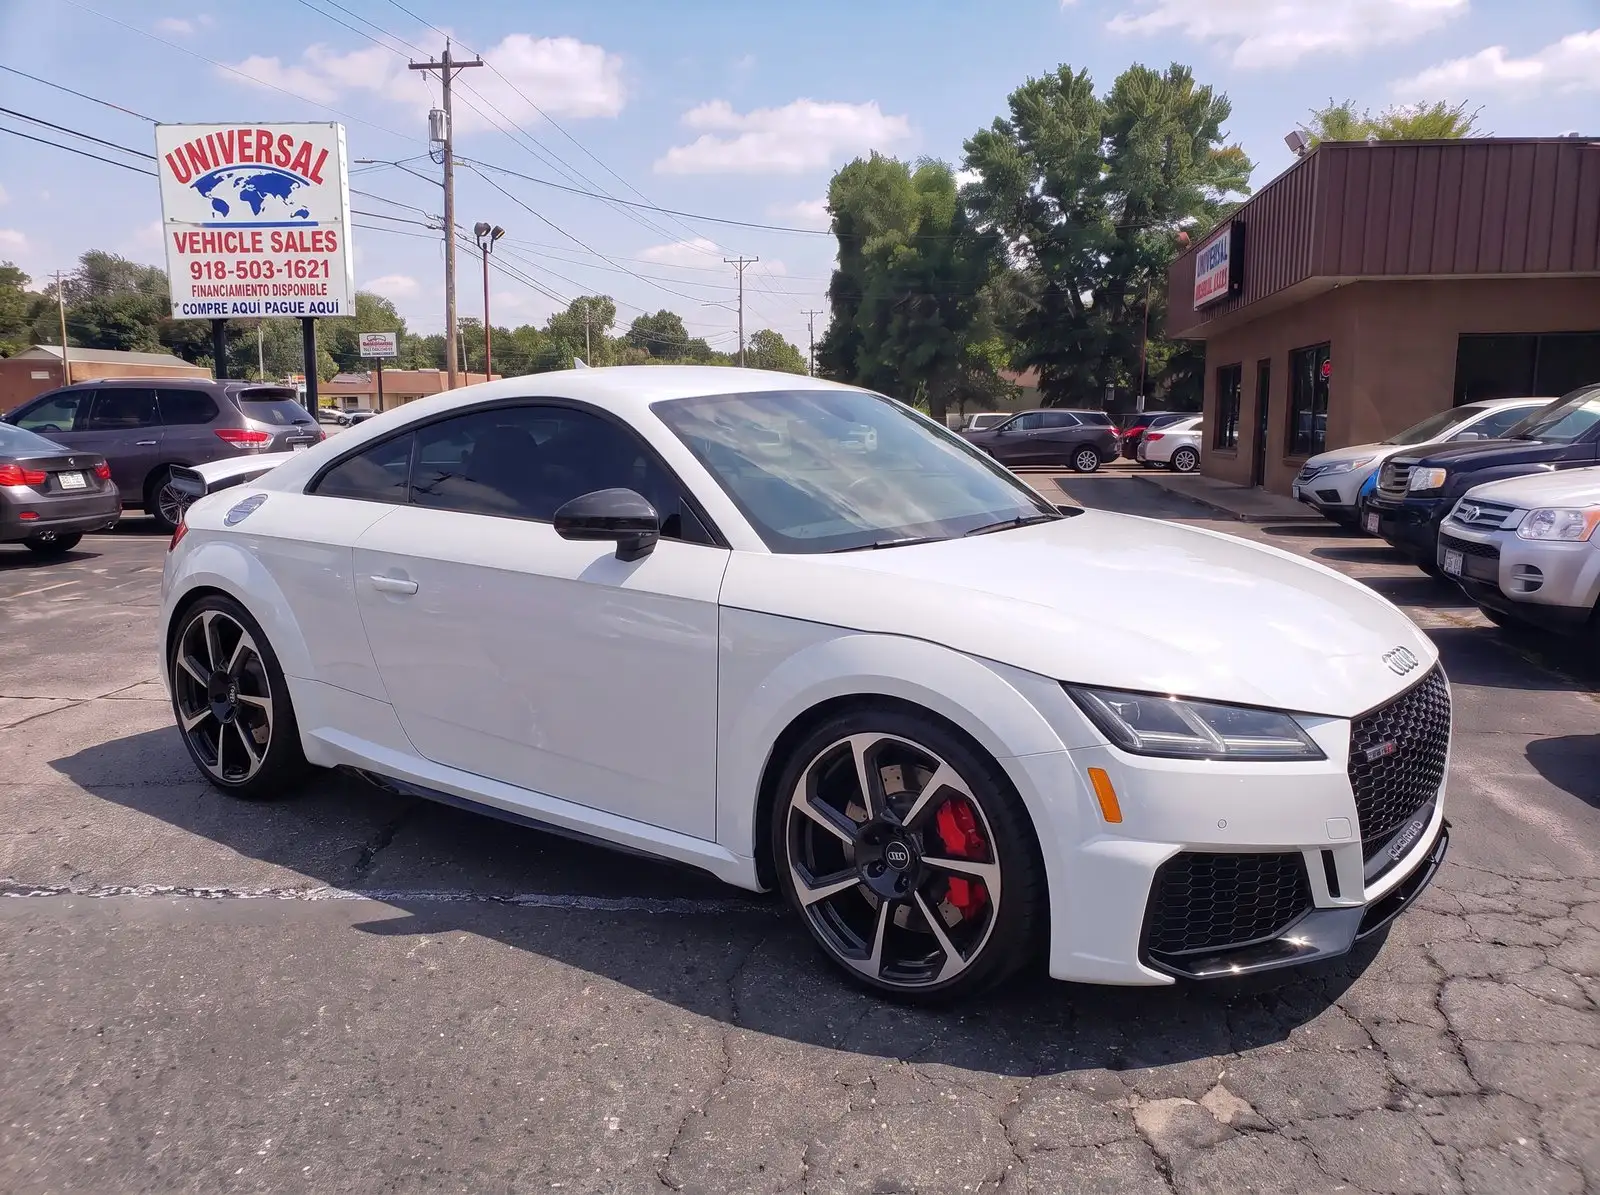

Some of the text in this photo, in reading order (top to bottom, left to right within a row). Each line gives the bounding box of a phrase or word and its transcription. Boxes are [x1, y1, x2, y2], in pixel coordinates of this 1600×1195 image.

[165, 129, 329, 184] UNIVERSAL
[173, 231, 337, 254] VEHICLE SALES
[190, 259, 329, 280] 918-503-1621
[192, 283, 327, 297] FINANCIAMIENTO DISPONIBLE
[183, 298, 339, 315] COMPRE AQUÍ PAGUE AQUÍ
